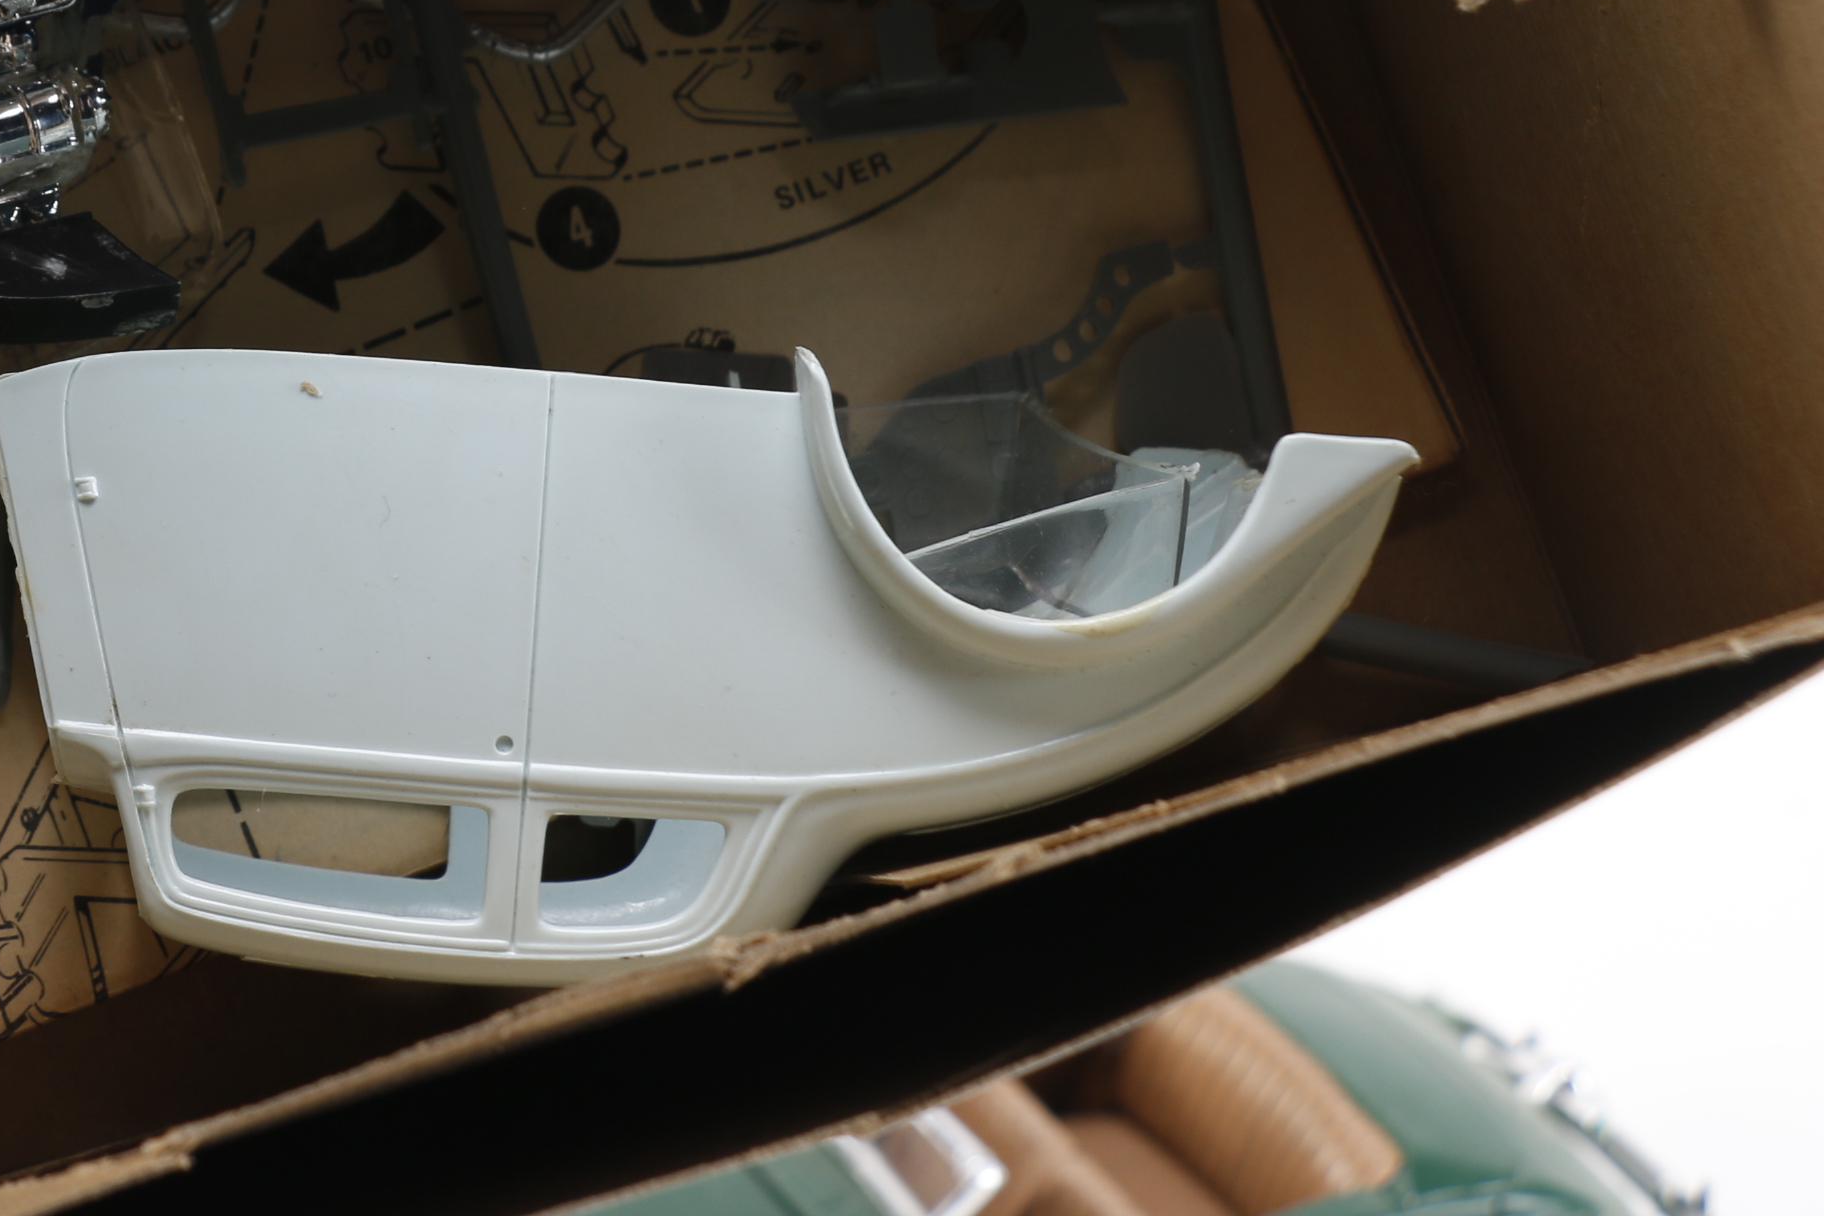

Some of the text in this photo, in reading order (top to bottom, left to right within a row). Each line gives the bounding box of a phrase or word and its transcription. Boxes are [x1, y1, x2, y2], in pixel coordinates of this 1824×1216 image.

[357, 33, 393, 64] 10
[773, 153, 894, 211] SILVER
[567, 203, 597, 248] 4
